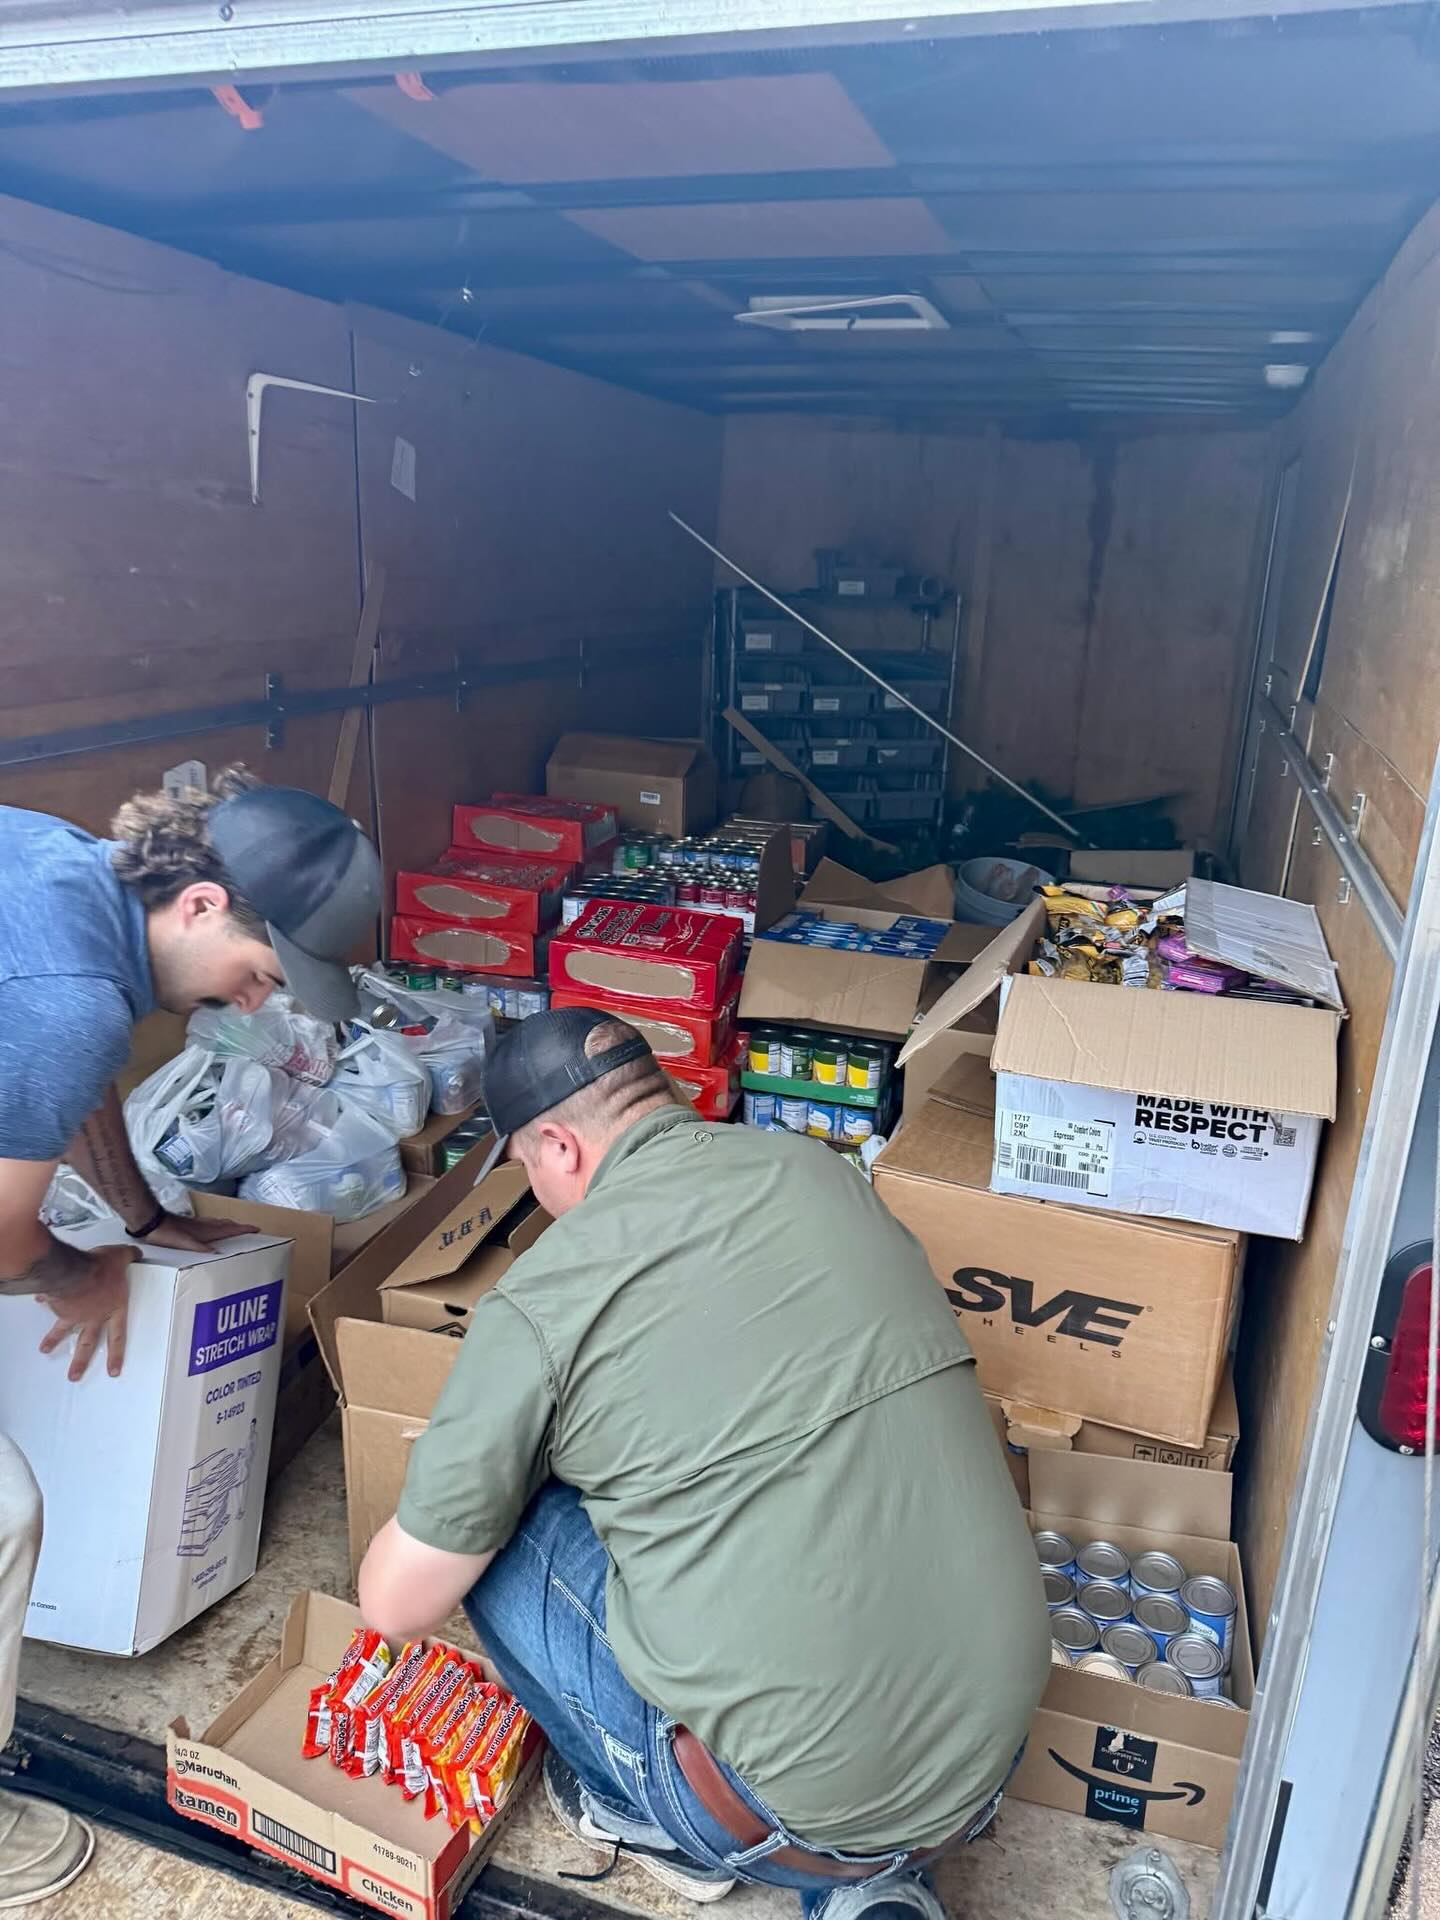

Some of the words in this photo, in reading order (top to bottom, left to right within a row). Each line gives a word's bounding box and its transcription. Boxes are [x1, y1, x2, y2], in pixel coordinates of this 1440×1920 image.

[1014, 1113, 1031, 1122] 1717
[1136, 1094, 1204, 1115] MADE
[1209, 1104, 1269, 1123] WITH
[1134, 1108, 1267, 1143] RESPECT
[217, 1294, 269, 1334] ULINE
[944, 1267, 1145, 1347] SVE
[195, 1335, 246, 1366] STRETCH
[206, 1381, 236, 1405] COLOR
[189, 1750, 200, 1760] OZ
[185, 1760, 239, 1789] Maruchan
[175, 1788, 238, 1825] Ramen
[1095, 1789, 1140, 1807] prime
[373, 1843, 417, 1873] 41789-90211
[361, 1879, 414, 1912] Chicken
